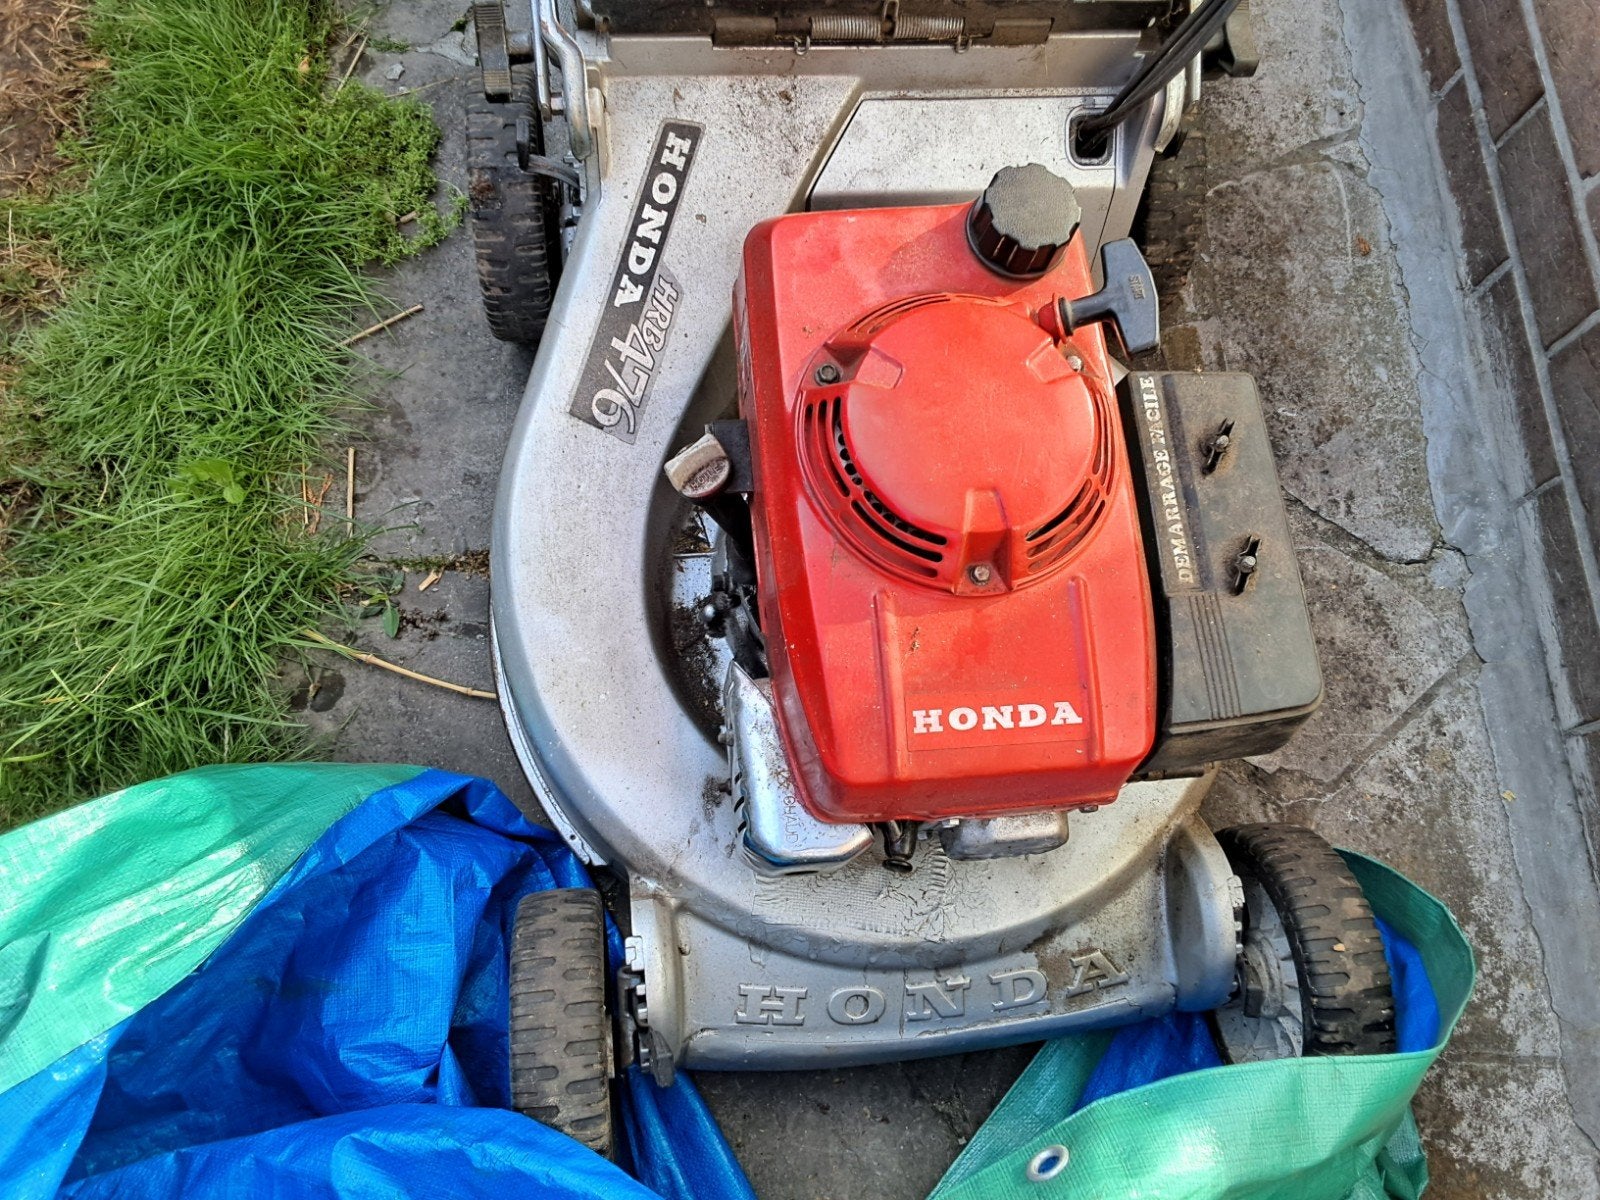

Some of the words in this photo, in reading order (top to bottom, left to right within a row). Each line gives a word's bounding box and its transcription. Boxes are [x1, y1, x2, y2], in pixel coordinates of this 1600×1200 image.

[614, 132, 691, 308] HONDA
[591, 274, 679, 435] HRB476
[1139, 375, 1167, 444] FACILE
[1153, 449, 1194, 584] DEMARRAGE
[912, 701, 1083, 734] HONDA
[783, 795, 799, 844] CHAUD
[735, 949, 1129, 1026] HONDA
